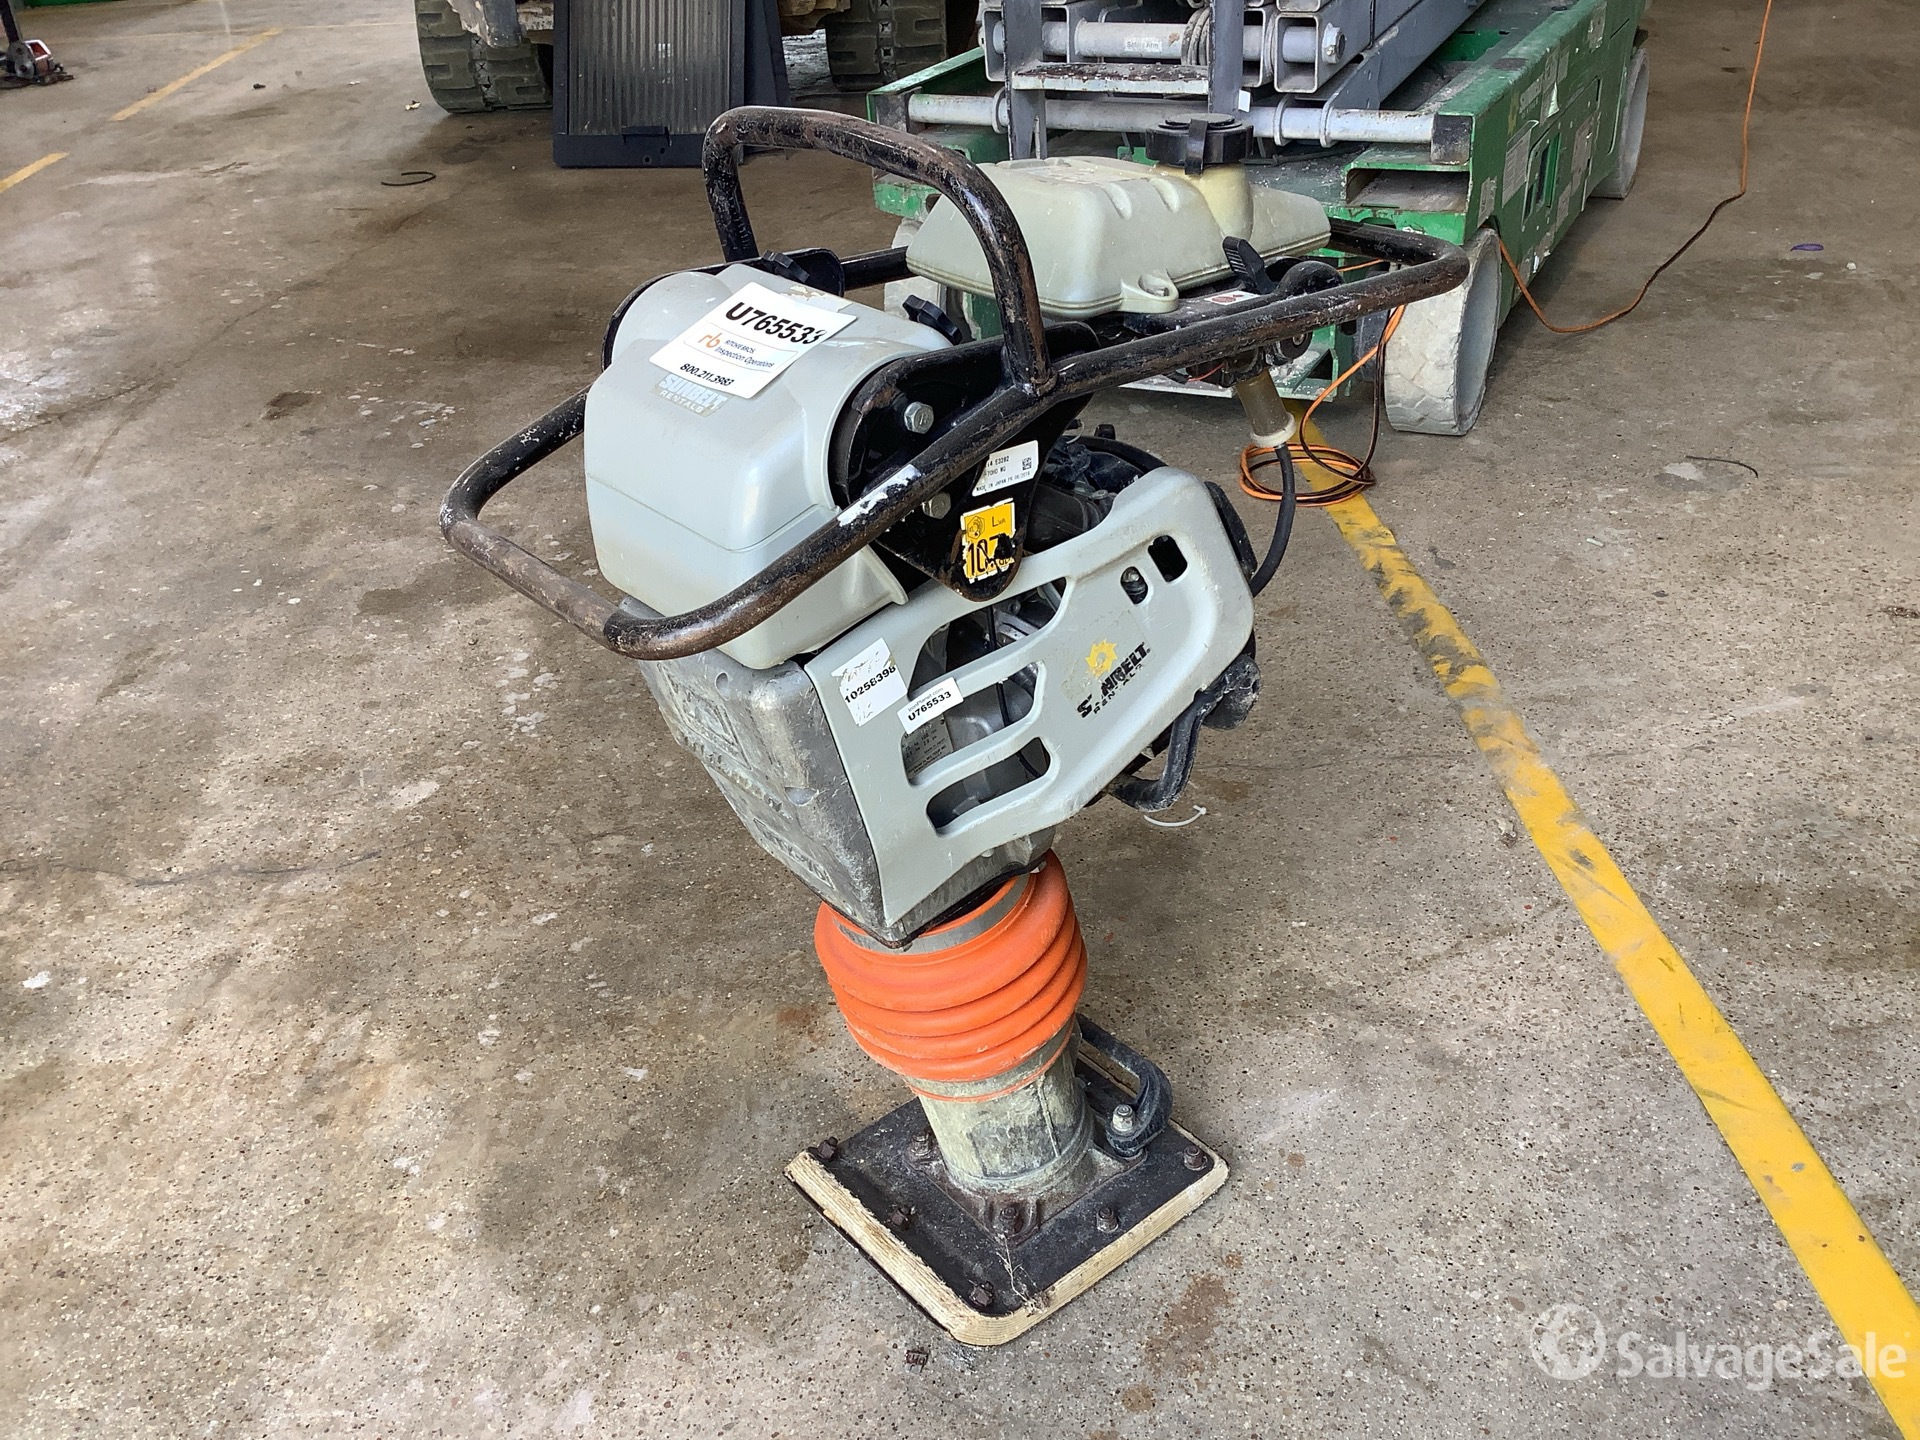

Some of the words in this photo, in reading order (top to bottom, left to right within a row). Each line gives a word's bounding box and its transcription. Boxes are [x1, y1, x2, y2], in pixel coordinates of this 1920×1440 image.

[725, 302, 827, 345] U765533
[698, 332, 722, 348] rb
[908, 691, 951, 721] U765533
